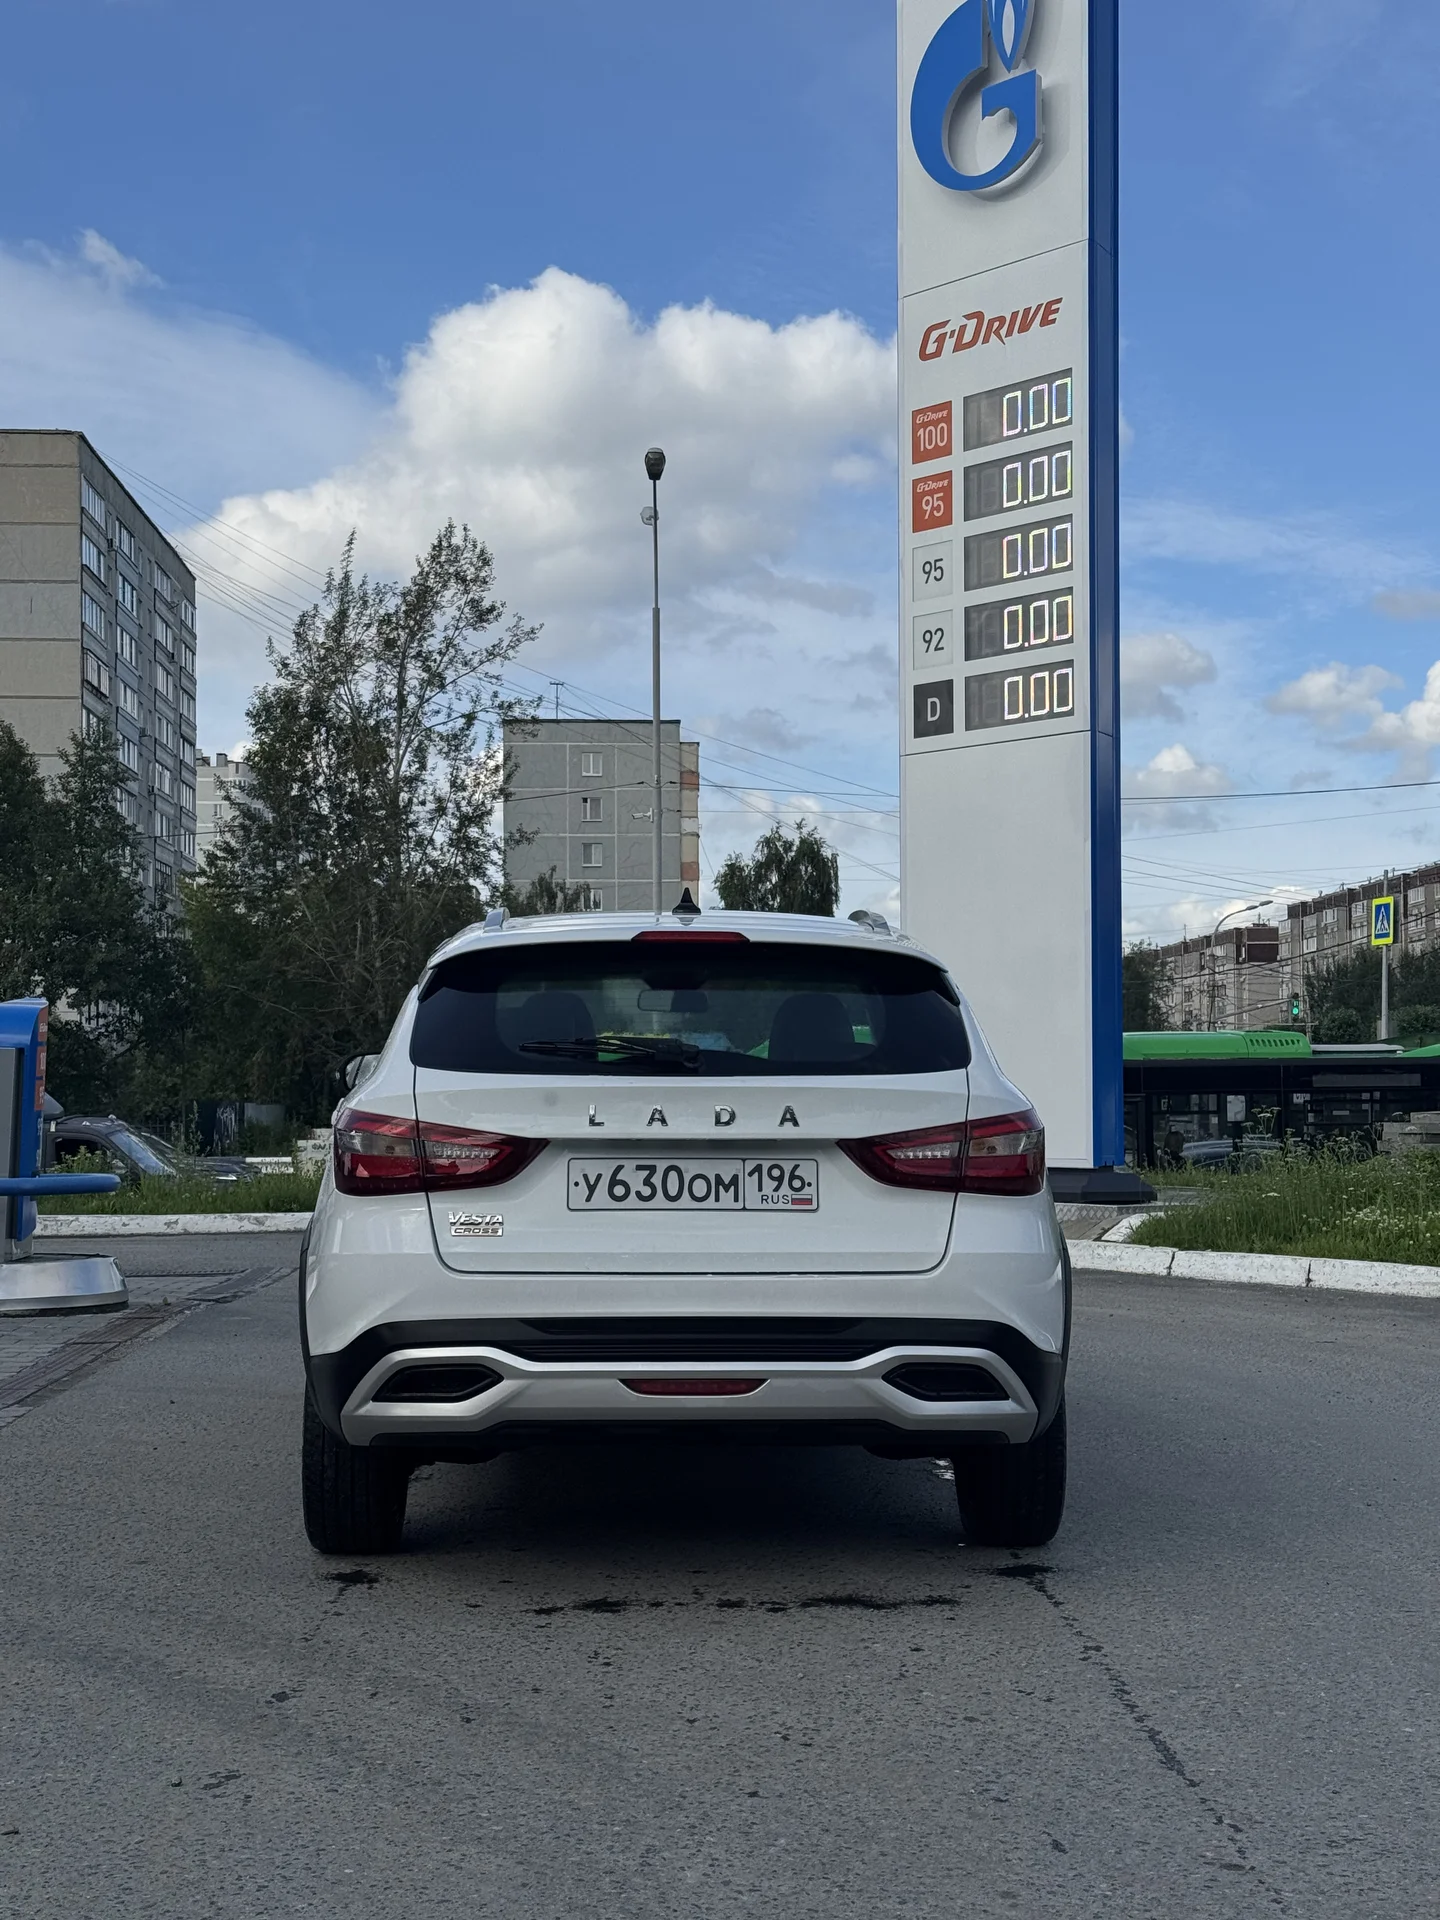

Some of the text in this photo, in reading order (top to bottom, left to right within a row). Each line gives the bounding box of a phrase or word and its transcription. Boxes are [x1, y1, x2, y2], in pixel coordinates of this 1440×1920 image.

[1002, 377, 1071, 437] 0.00
[917, 422, 948, 452] 100
[1002, 450, 1071, 508] 0.00
[922, 492, 944, 520] 95
[1002, 522, 1071, 578] 0.00
[922, 558, 944, 584] 95
[1003, 595, 1072, 650] 0.00
[922, 627, 945, 653] 92
[1003, 667, 1073, 720] 0.00
[927, 697, 941, 722] D
[588, 1104, 801, 1127] LADA
[747, 1163, 806, 1192] 196
[760, 1194, 790, 1205] RUS
[448, 1211, 504, 1226] VESTA
